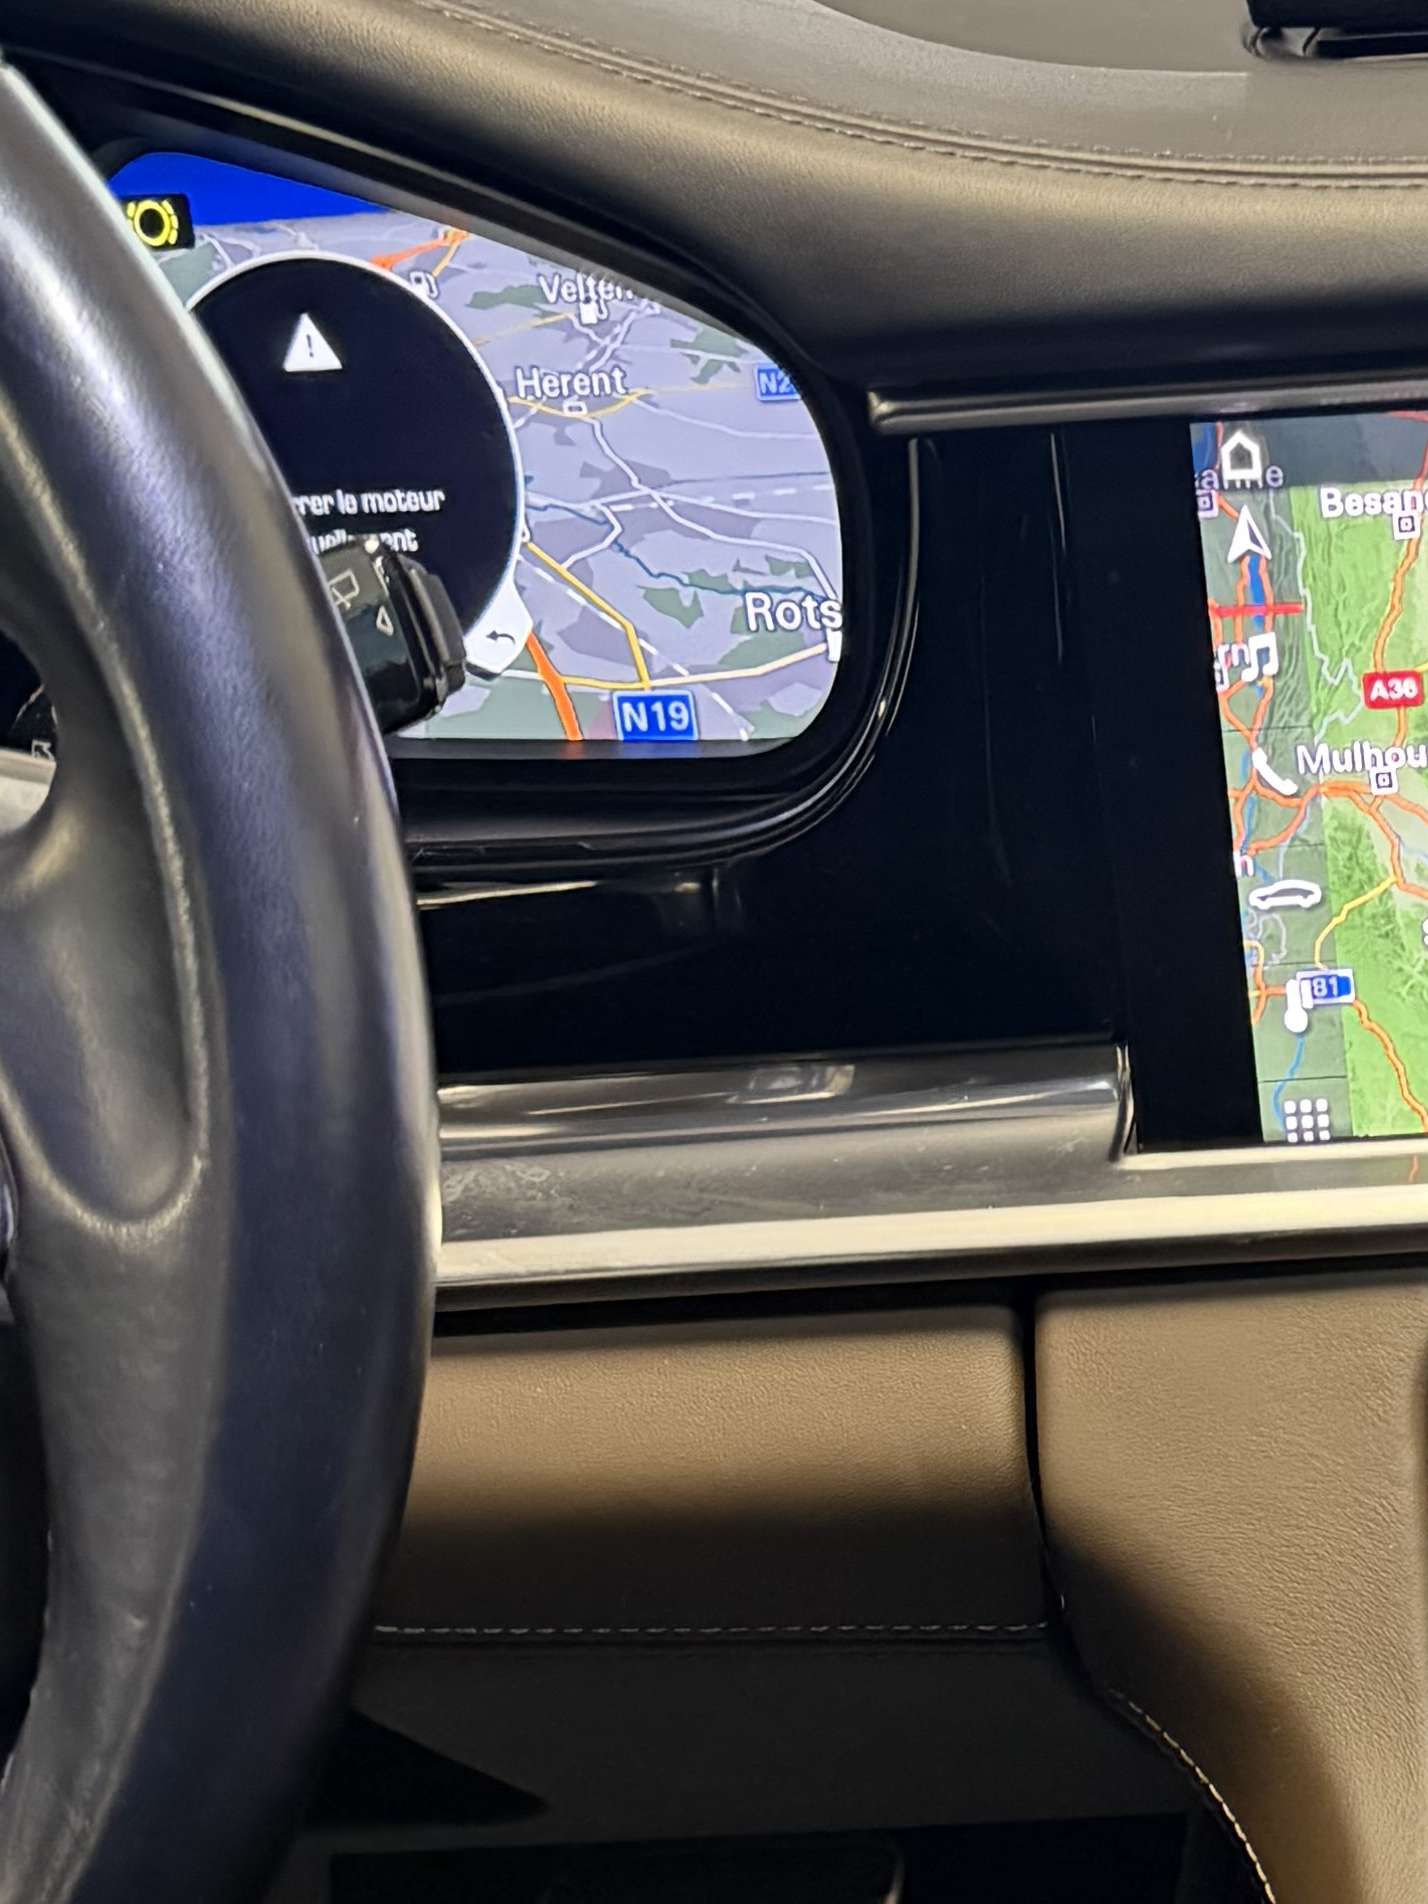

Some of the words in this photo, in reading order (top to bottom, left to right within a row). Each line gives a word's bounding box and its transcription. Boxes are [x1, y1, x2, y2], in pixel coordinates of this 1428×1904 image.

[515, 367, 628, 398] Herent
[337, 488, 357, 514] le
[361, 489, 446, 513] moteur
[745, 592, 842, 633] Rots
[622, 702, 691, 734] N19
